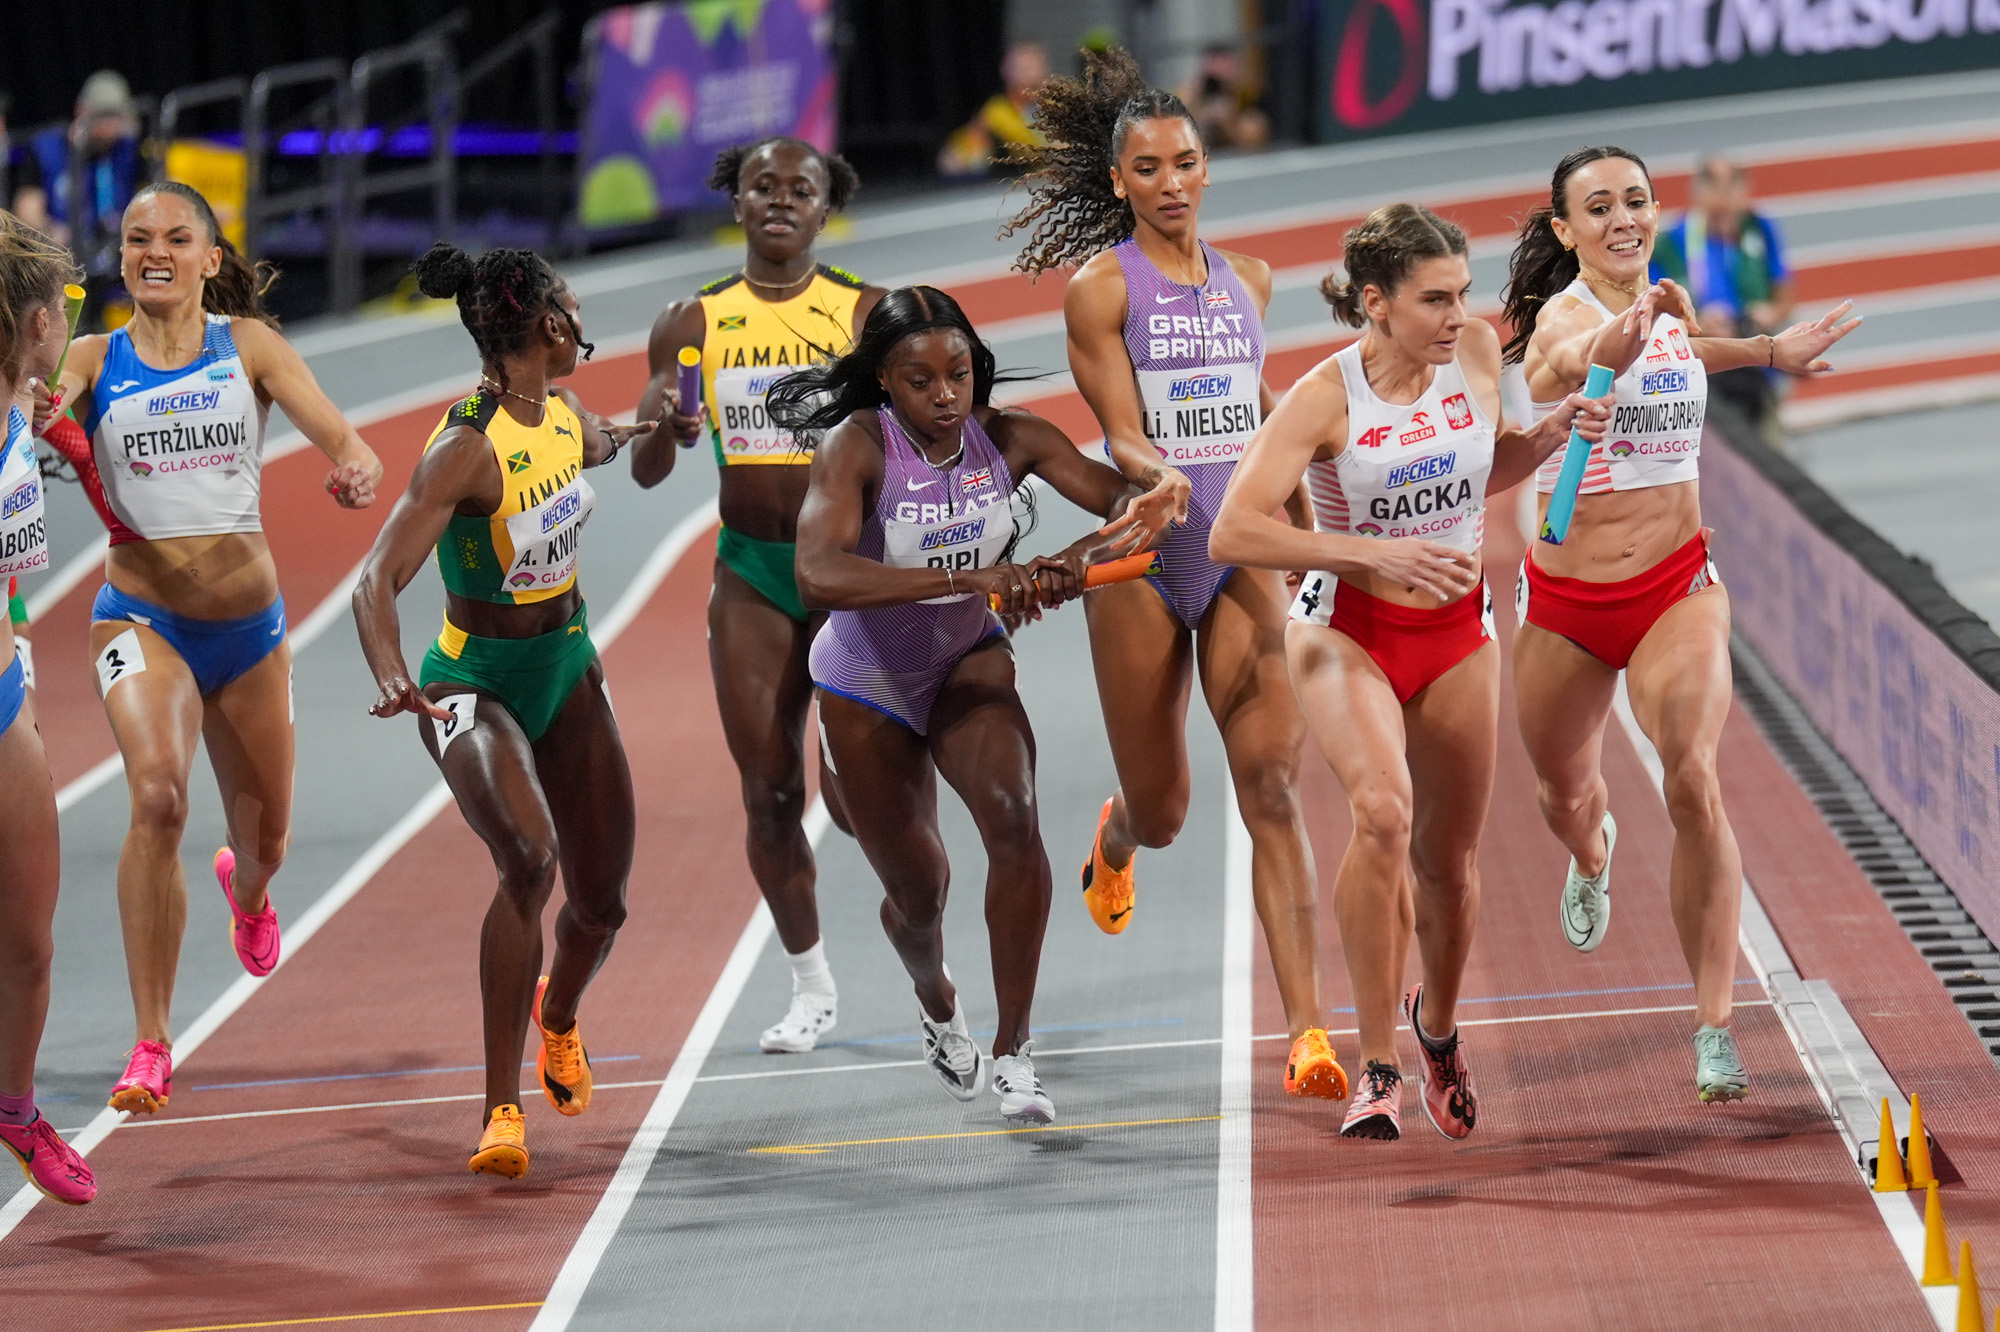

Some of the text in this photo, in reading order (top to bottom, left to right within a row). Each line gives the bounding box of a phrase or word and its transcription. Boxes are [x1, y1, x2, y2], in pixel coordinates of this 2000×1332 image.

[1149, 314, 1242, 336] GREAT
[1150, 338, 1251, 360] BRITAIN
[1168, 375, 1231, 400] HI-CHEW
[1642, 370, 1687, 394] HI-CHEW
[147, 390, 219, 415] HI-CHEW
[1143, 403, 1256, 439] Li. NIELSEN
[123, 415, 246, 458] PETRŽILKOVÁ
[1357, 426, 1393, 448] 4F
[1401, 426, 1435, 445] ORLEN
[1640, 440, 1690, 455] GLASGO
[159, 452, 236, 473] GLASGOW
[1174, 443, 1245, 460] GLASGOW
[1386, 451, 1456, 489] HI-CHEW
[2, 479, 39, 519] HI-CHEW
[541, 489, 580, 533] HI-CHEW
[896, 491, 999, 524] GREAT
[1370, 478, 1472, 521] GACKA
[920, 518, 985, 550] HI-CHEW
[1389, 512, 1464, 537] GLASGOW
[0, 550, 47, 573] GLASGO
[515, 549, 537, 569] A.
[106, 648, 125, 681] 3
[444, 702, 459, 738] 6
